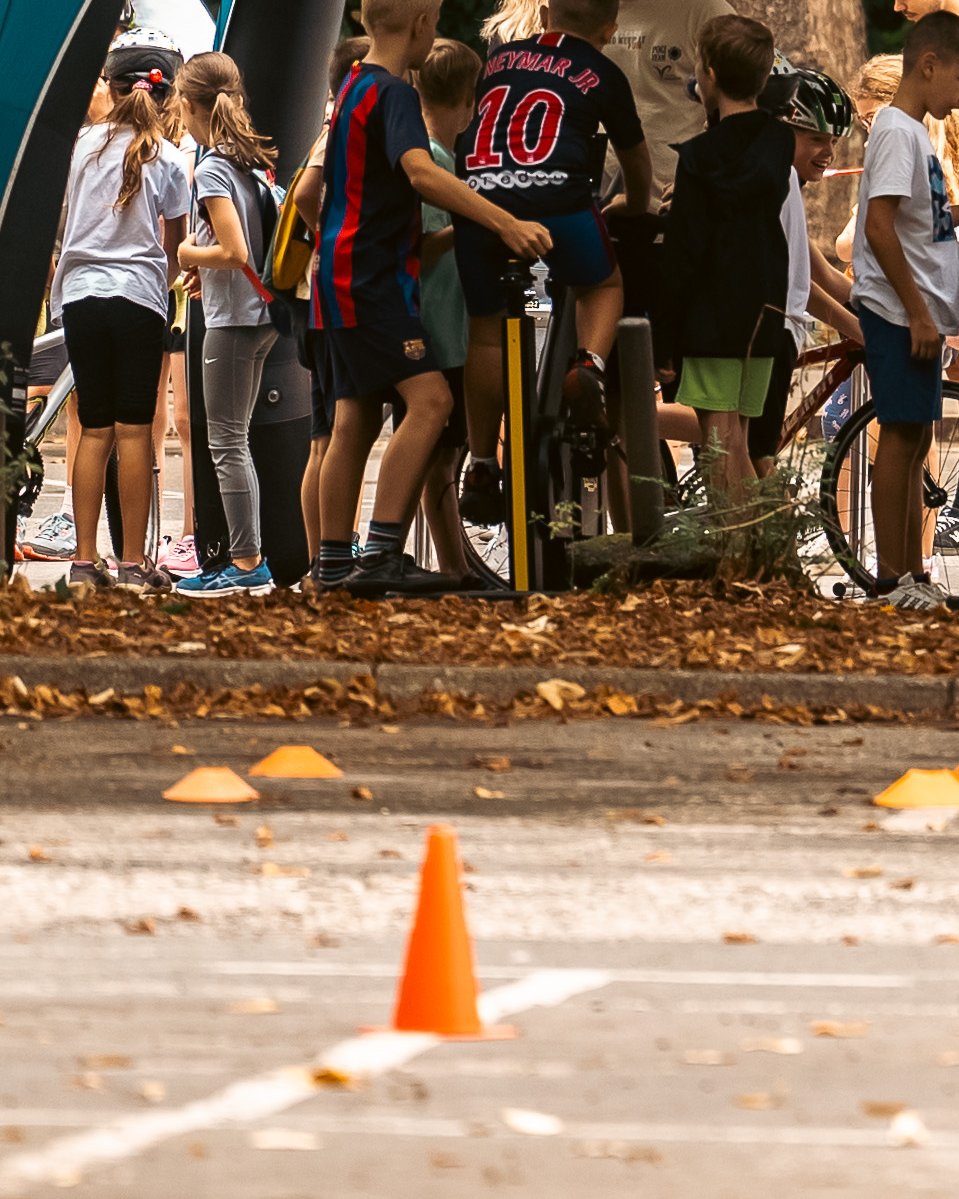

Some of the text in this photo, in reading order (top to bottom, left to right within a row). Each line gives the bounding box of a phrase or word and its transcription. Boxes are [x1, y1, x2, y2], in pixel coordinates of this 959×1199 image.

[482, 50, 600, 95] NEYMAR JR
[466, 85, 565, 170] 10
